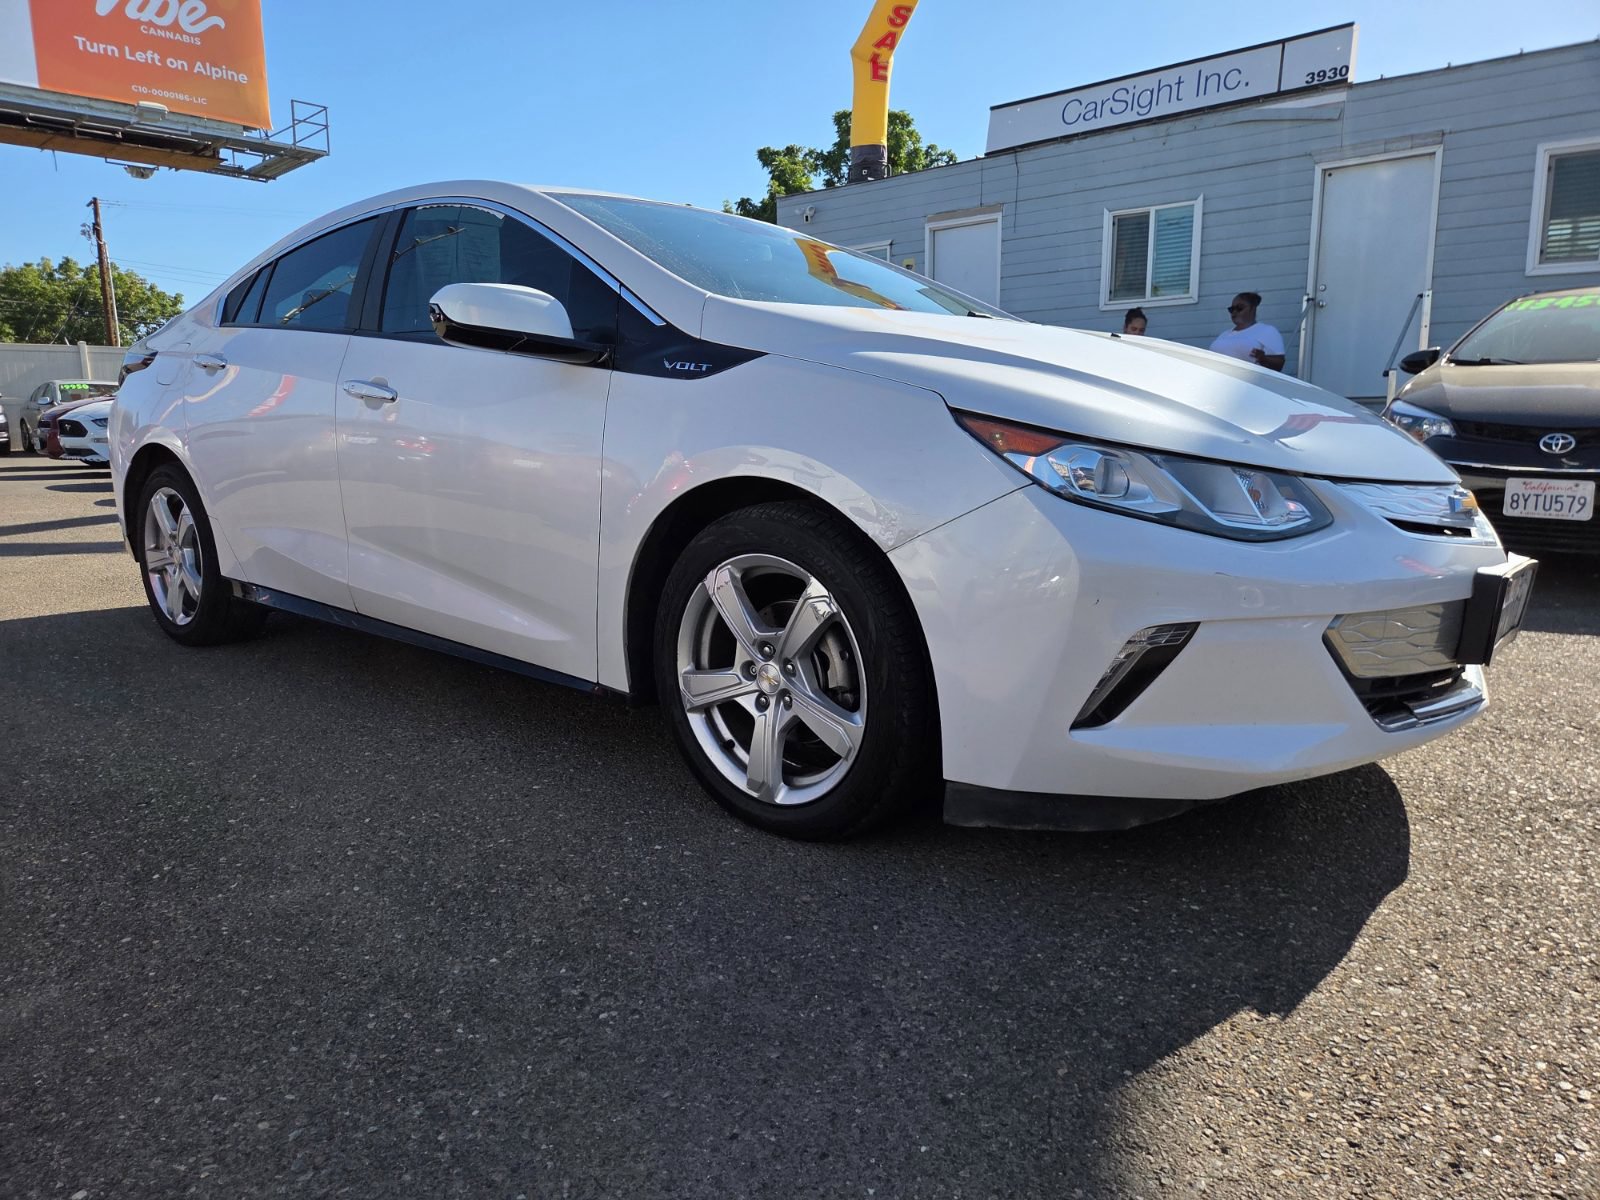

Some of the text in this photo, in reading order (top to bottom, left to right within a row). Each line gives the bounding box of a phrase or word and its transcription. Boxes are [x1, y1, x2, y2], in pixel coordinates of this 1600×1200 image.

[140, 25, 201, 46] CANNABIS
[73, 35, 249, 84] Turn Left on Alpine
[1304, 64, 1350, 85] 3930
[1061, 67, 1250, 126] CarSight Inc.
[663, 357, 713, 371] VOLT
[1510, 492, 1587, 513] 8YTU579
